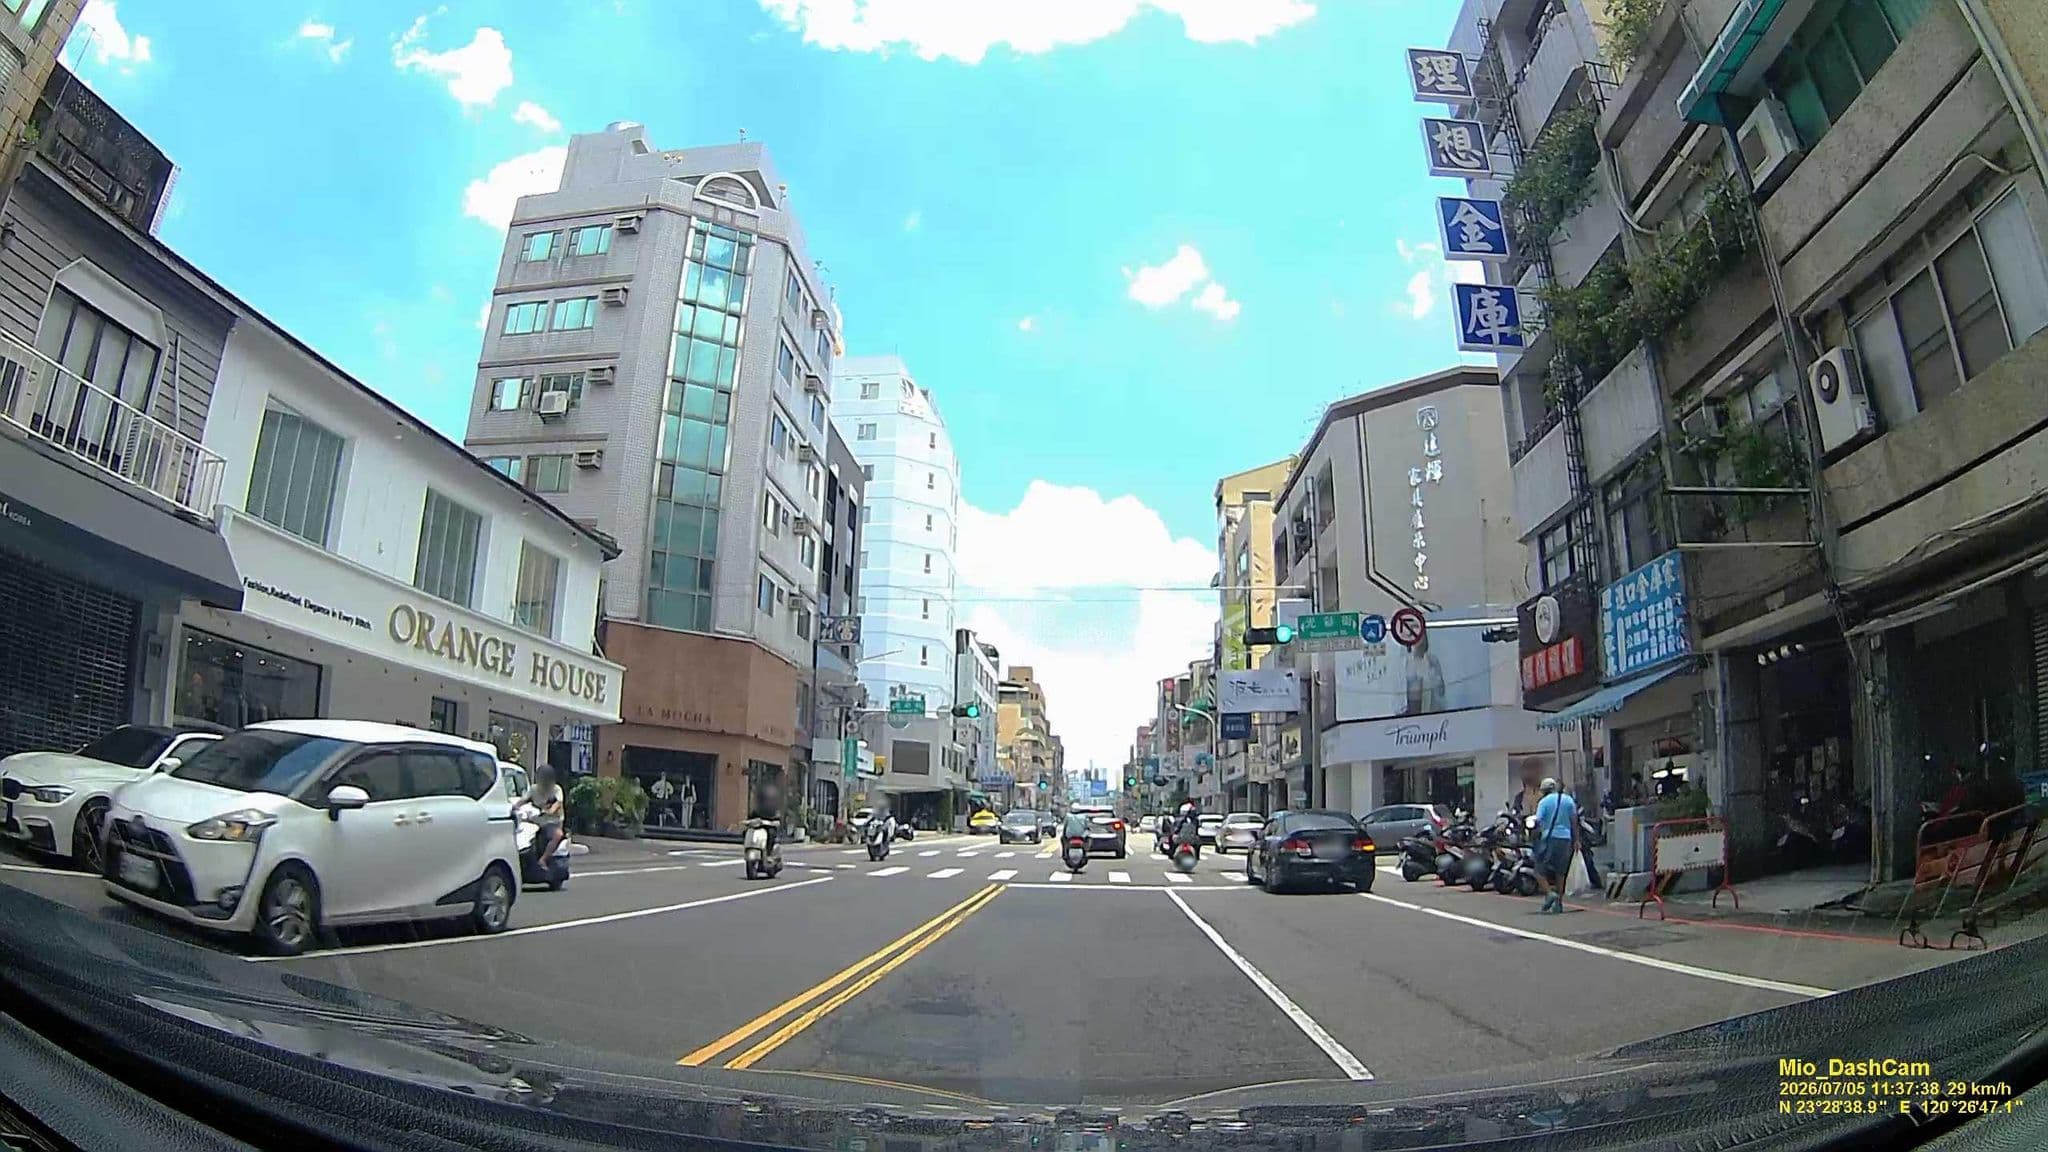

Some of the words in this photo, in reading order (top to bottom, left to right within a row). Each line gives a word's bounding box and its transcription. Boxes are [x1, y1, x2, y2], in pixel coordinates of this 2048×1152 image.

[1414, 55, 1521, 345] 理想金庫
[389, 604, 517, 678] ORANGE
[530, 652, 608, 704] HOUSE
[660, 708, 712, 724] MOCHA
[1384, 719, 1449, 751] Triumph
